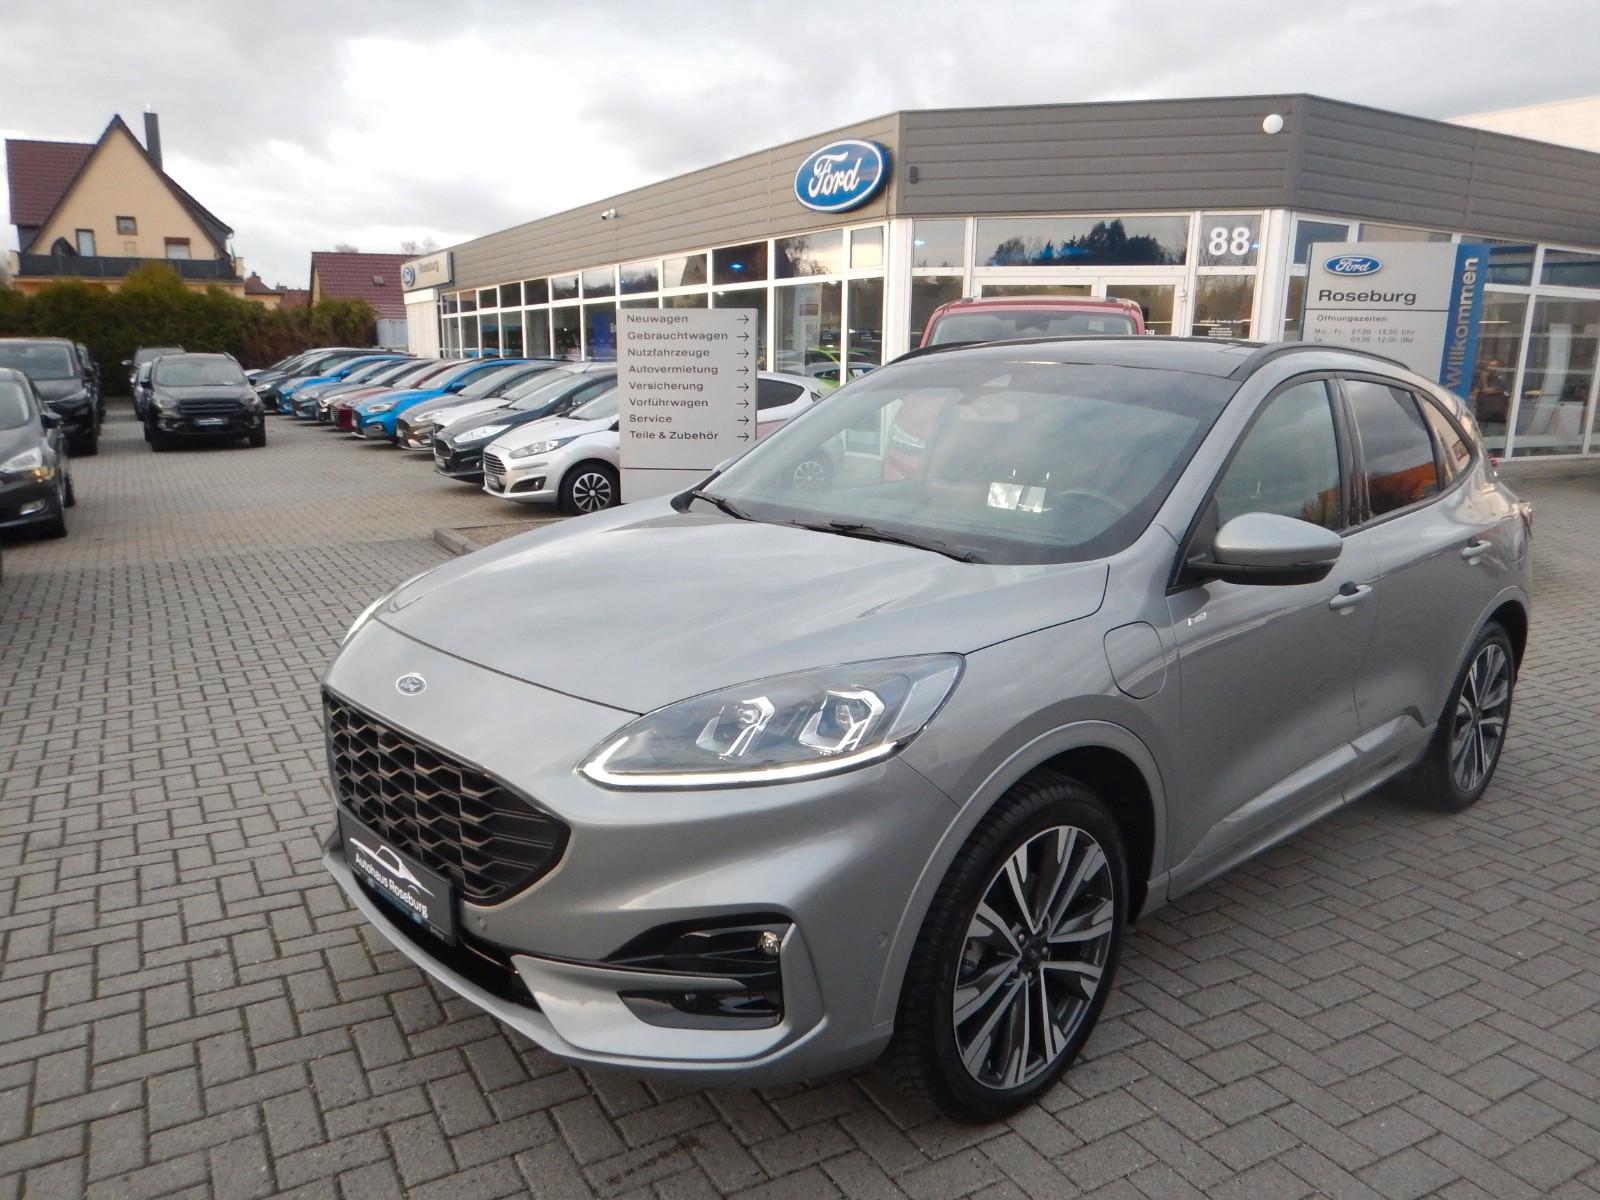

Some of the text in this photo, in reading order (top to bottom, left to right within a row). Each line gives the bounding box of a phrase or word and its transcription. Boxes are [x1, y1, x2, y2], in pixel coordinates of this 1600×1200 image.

[808, 151, 862, 198] Ford
[1208, 226, 1250, 256] 88
[1336, 257, 1372, 272] Ford
[1318, 289, 1417, 306] Roseburg
[626, 314, 688, 324] Neuwagen
[1444, 257, 1479, 389] Willkommen
[627, 331, 728, 342] Gebrauchtwagen
[627, 348, 710, 359] Nutzfahrzeuge
[628, 365, 719, 375] Autovermietung
[628, 381, 704, 391] Versicherung
[628, 397, 709, 408] Vorführwagen
[629, 414, 673, 423] Service
[630, 430, 719, 440] Teile & Zubehör
[355, 853, 429, 919] Autohaus Roseburg
